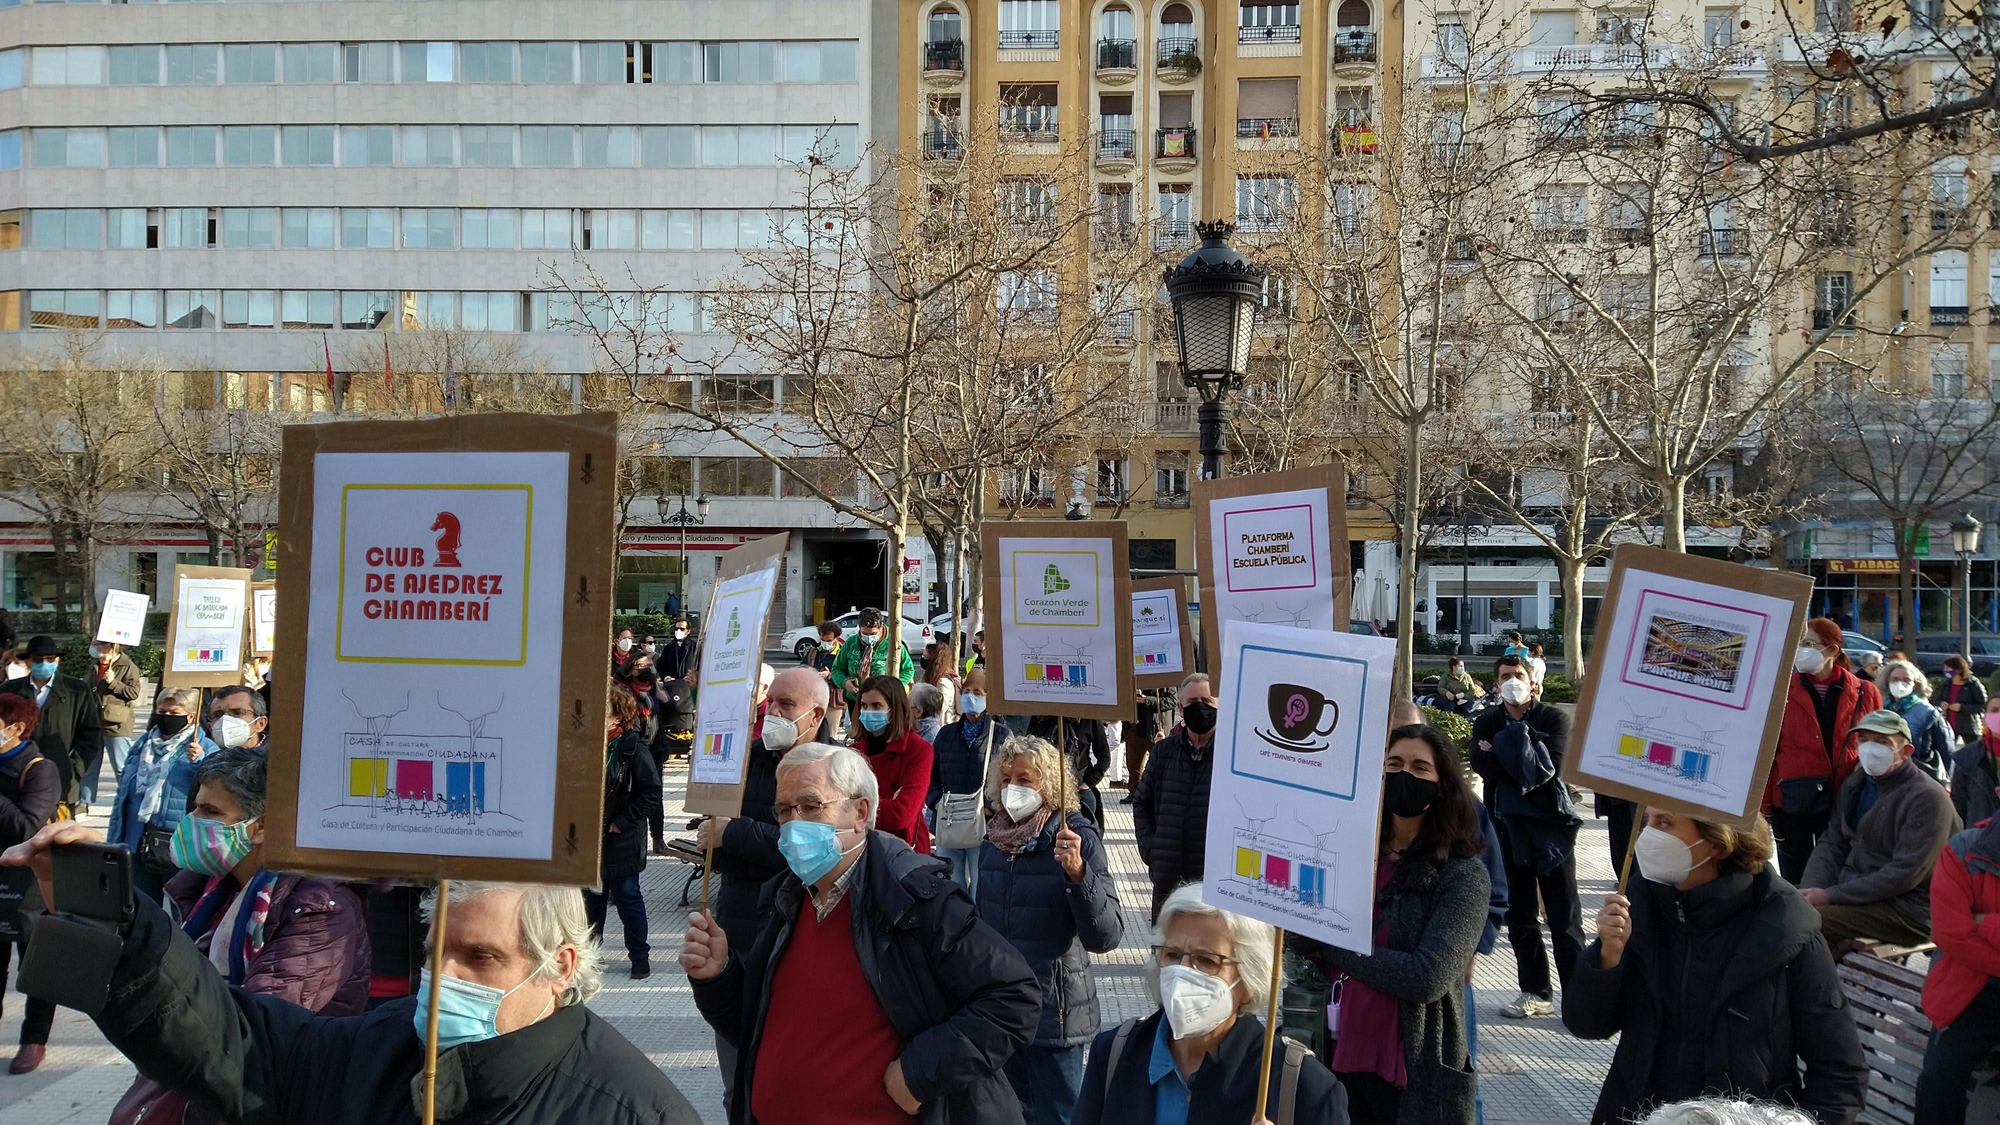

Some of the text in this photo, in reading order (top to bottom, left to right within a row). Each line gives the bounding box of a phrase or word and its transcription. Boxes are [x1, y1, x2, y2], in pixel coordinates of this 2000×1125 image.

[642, 534, 675, 542] Atención
[1241, 531, 1295, 544] PLATAFORMA
[1247, 542, 1290, 555] CHAMBERÍ
[365, 546, 425, 567] CLUB
[1233, 554, 1307, 569] ESCUELA PÚBLICA
[365, 573, 503, 595] DE AJEDREZ
[363, 596, 491, 621] CHAMBERÍ
[1024, 598, 1089, 607] Corazón Verde
[1029, 608, 1085, 617] de Chamberí
[714, 647, 746, 660] Corazón Verde
[714, 660, 742, 672] de Chamberí
[1642, 664, 1692, 682] PARQUE
[349, 737, 382, 746] CASA
[427, 749, 497, 759] CIUDADANA
[321, 819, 338, 829] Casa
[340, 820, 350, 829] de
[351, 820, 378, 831] Cultura
[386, 822, 433, 834] Participación
[434, 824, 473, 835] Ciudadana
[474, 827, 485, 836] de
[1236, 831, 1258, 841] CASA
[1217, 886, 1228, 896] Casa
[1228, 890, 1235, 898] de
[1236, 891, 1253, 904] Cultura
[1258, 899, 1289, 914] Participación
